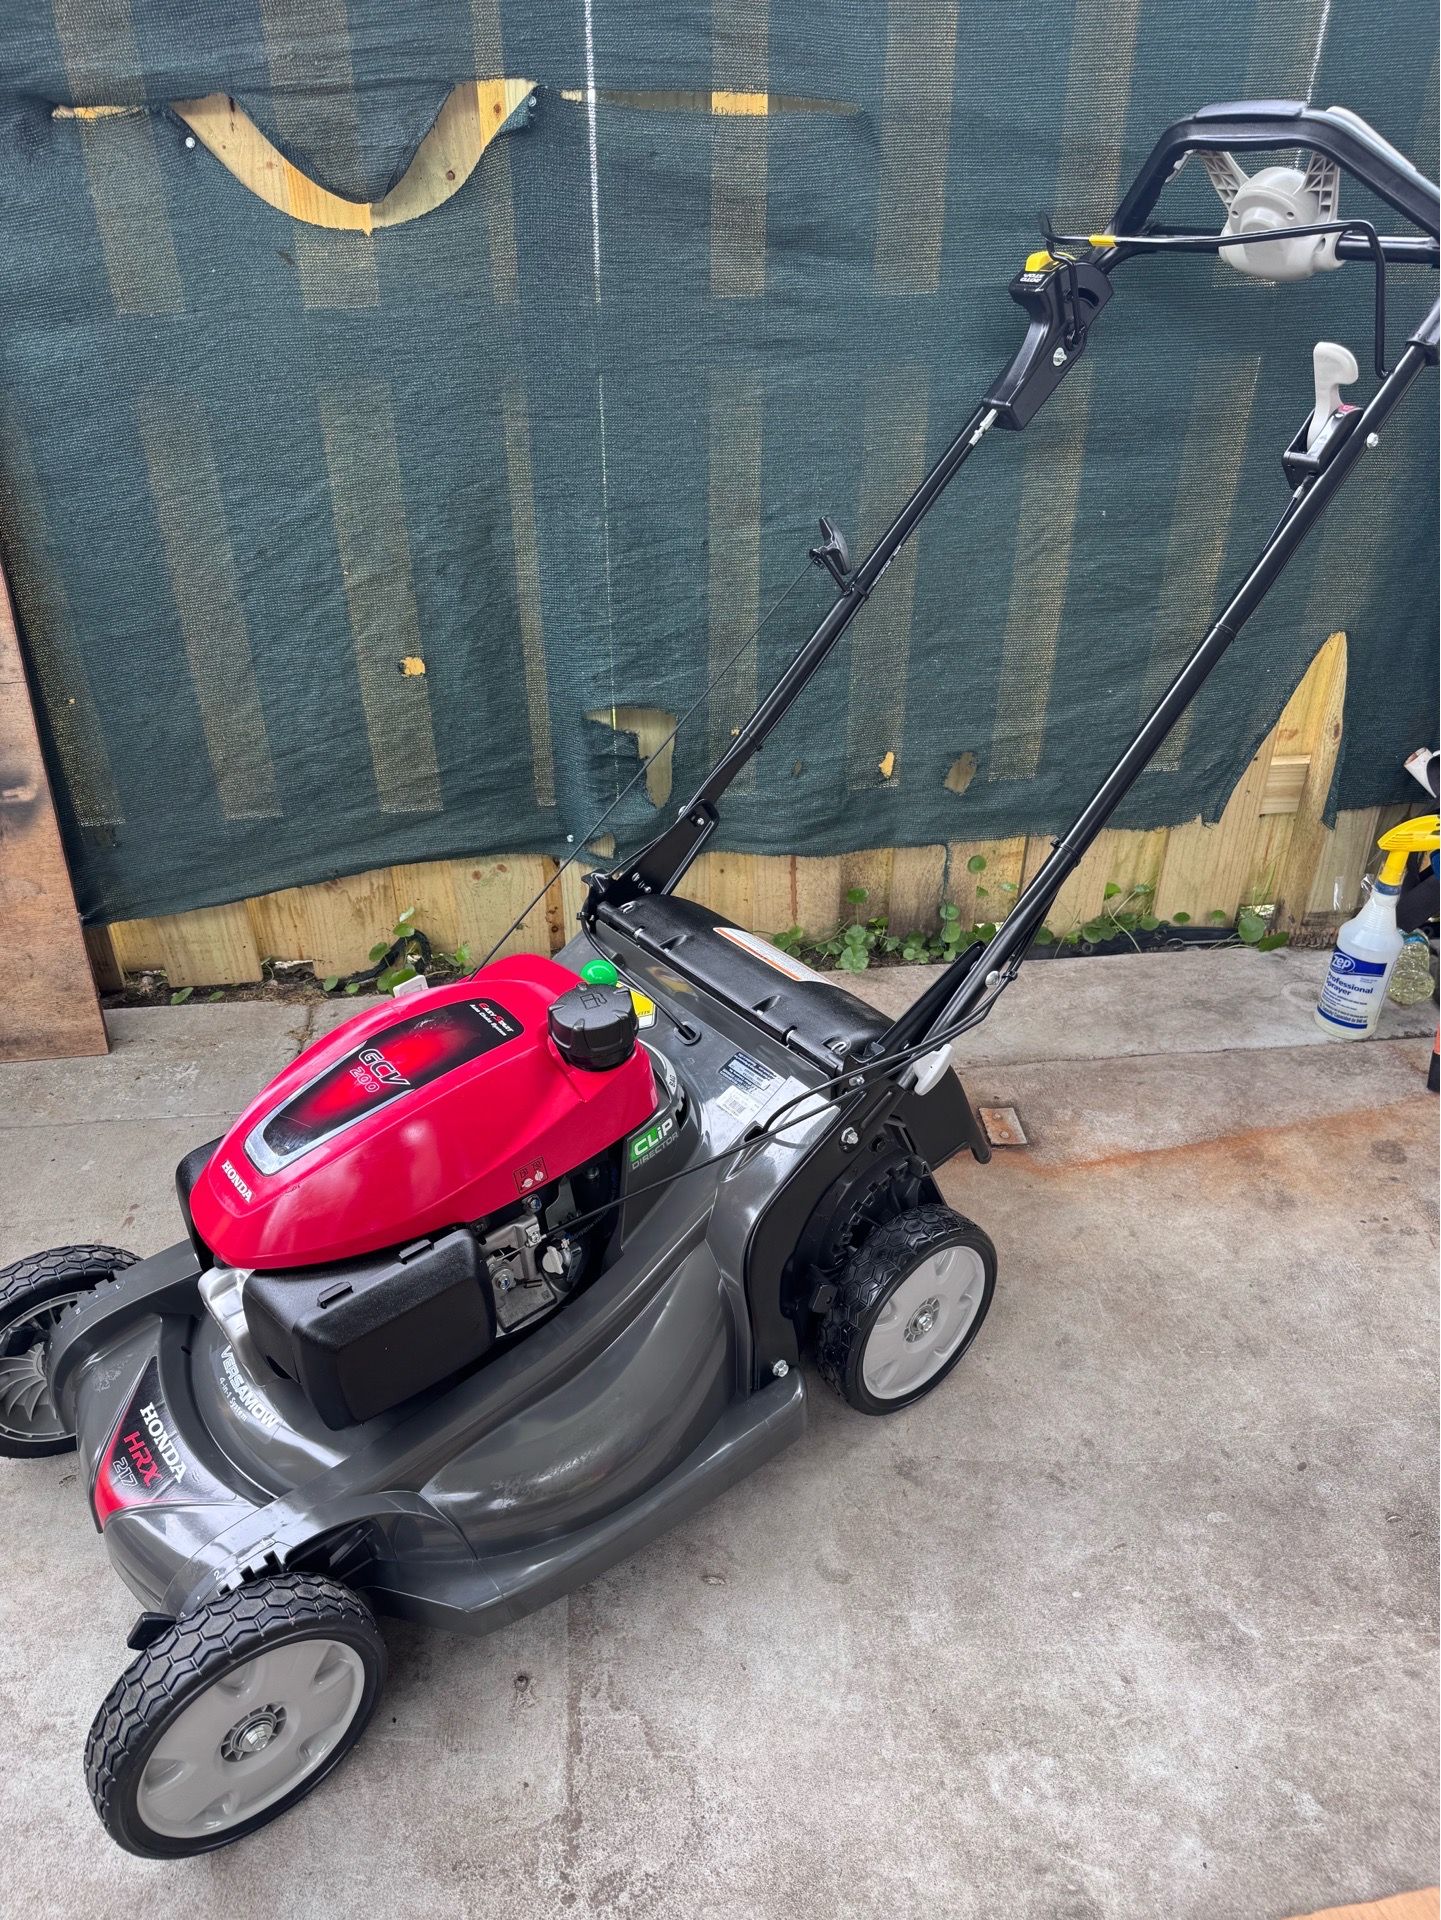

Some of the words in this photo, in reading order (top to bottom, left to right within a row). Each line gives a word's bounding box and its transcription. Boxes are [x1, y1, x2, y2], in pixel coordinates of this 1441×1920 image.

[349, 1066, 380, 1093] 200
[359, 1048, 411, 1086] GCV
[632, 1131, 679, 1170] DIRECTOR
[221, 1160, 253, 1204] HONDA
[220, 1377, 232, 1399] 4-in-1
[229, 1397, 248, 1422] System
[221, 1344, 280, 1429] VERSAMOW
[123, 1431, 163, 1488] HRX
[139, 1402, 187, 1484] HONDA
[112, 1456, 138, 1488] 217
